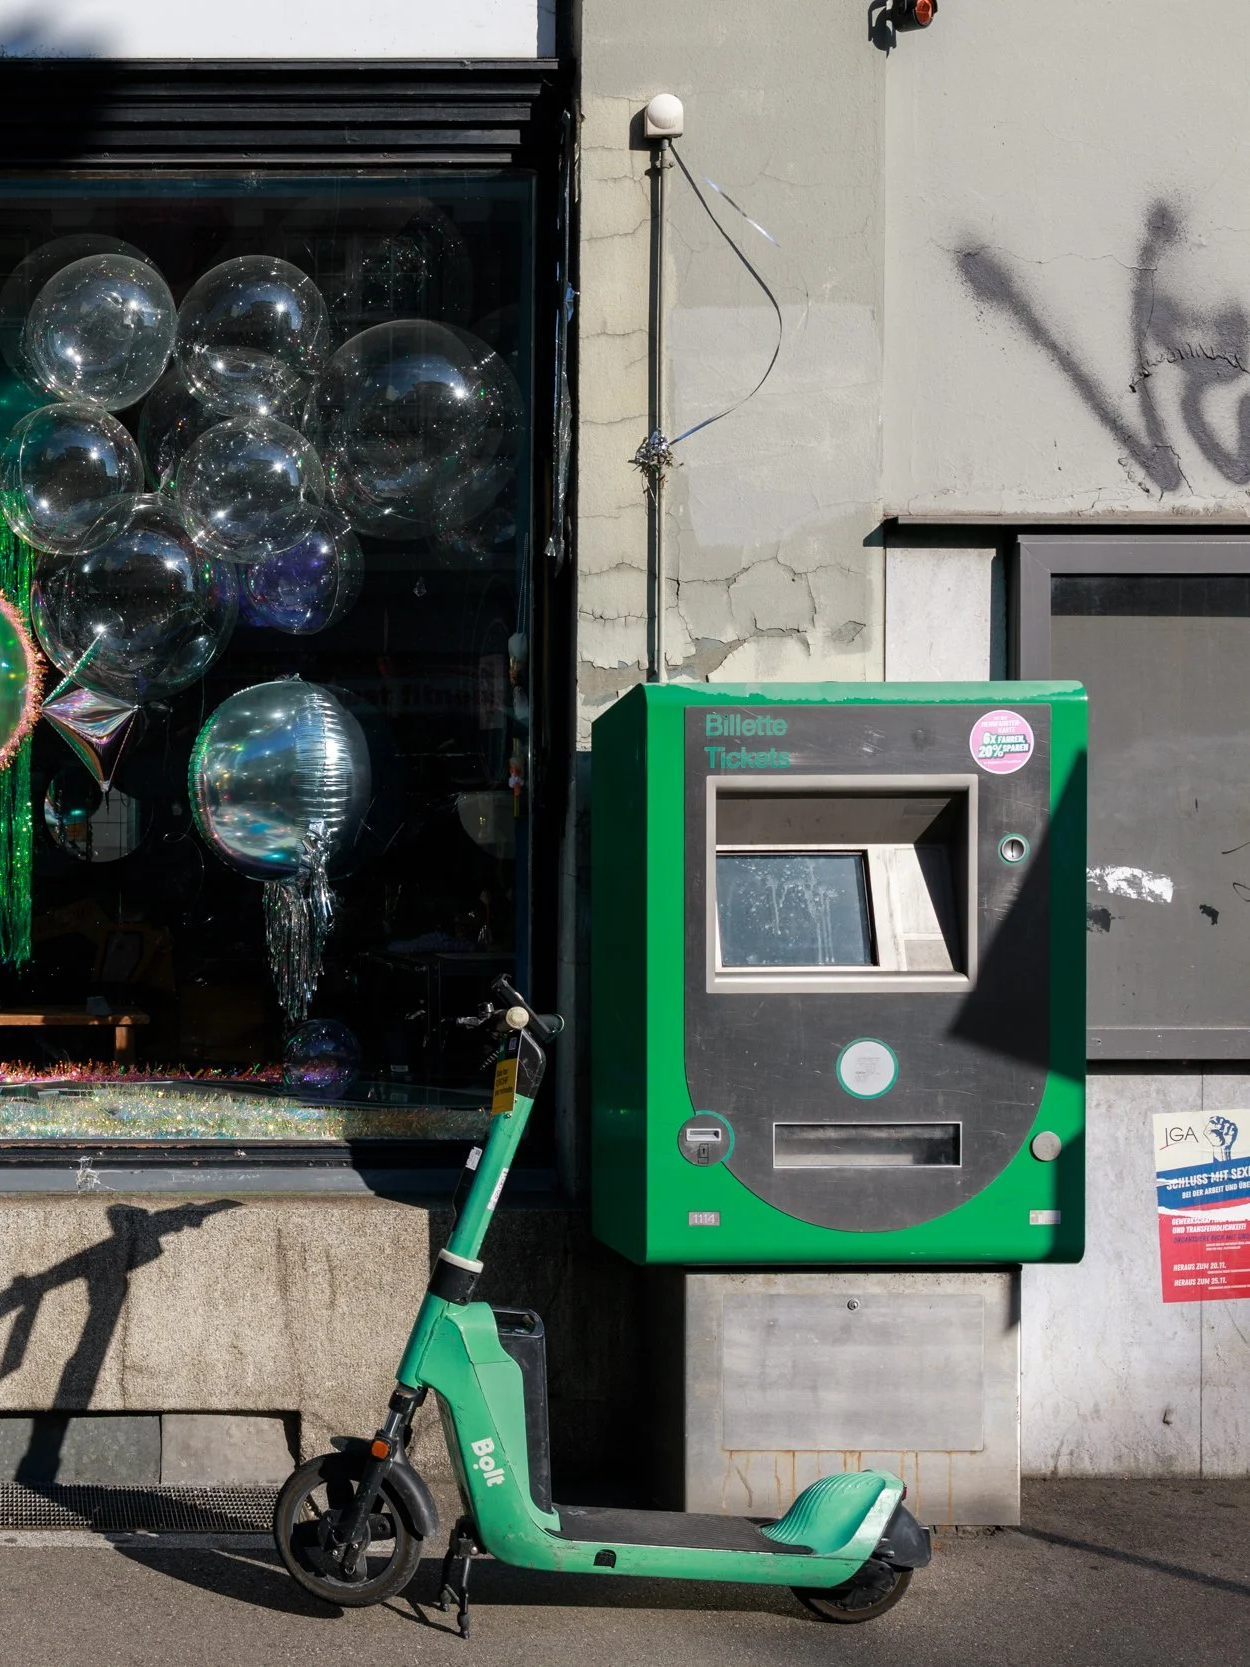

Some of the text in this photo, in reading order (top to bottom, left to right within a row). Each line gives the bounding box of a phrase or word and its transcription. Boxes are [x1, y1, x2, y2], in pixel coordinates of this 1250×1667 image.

[705, 713, 788, 737] Billette
[704, 745, 792, 769] Tickets
[978, 744, 1030, 759] 20% SPAREN
[1166, 1173, 1208, 1190] SCHLUSS
[1210, 1169, 1229, 1183] MIT
[1181, 1191, 1191, 1199] BEI
[1192, 1189, 1204, 1197] DER
[1204, 1185, 1224, 1195] ARBEIT
[1225, 1183, 1238, 1192] UND
[693, 1213, 716, 1224] 1114
[1171, 1226, 1186, 1234] UND
[1173, 1261, 1227, 1272] HERAUS ZUM 20.11.
[1173, 1276, 1228, 1287] HERAUS ZUM 25.11.
[471, 1437, 505, 1487] Bolt
